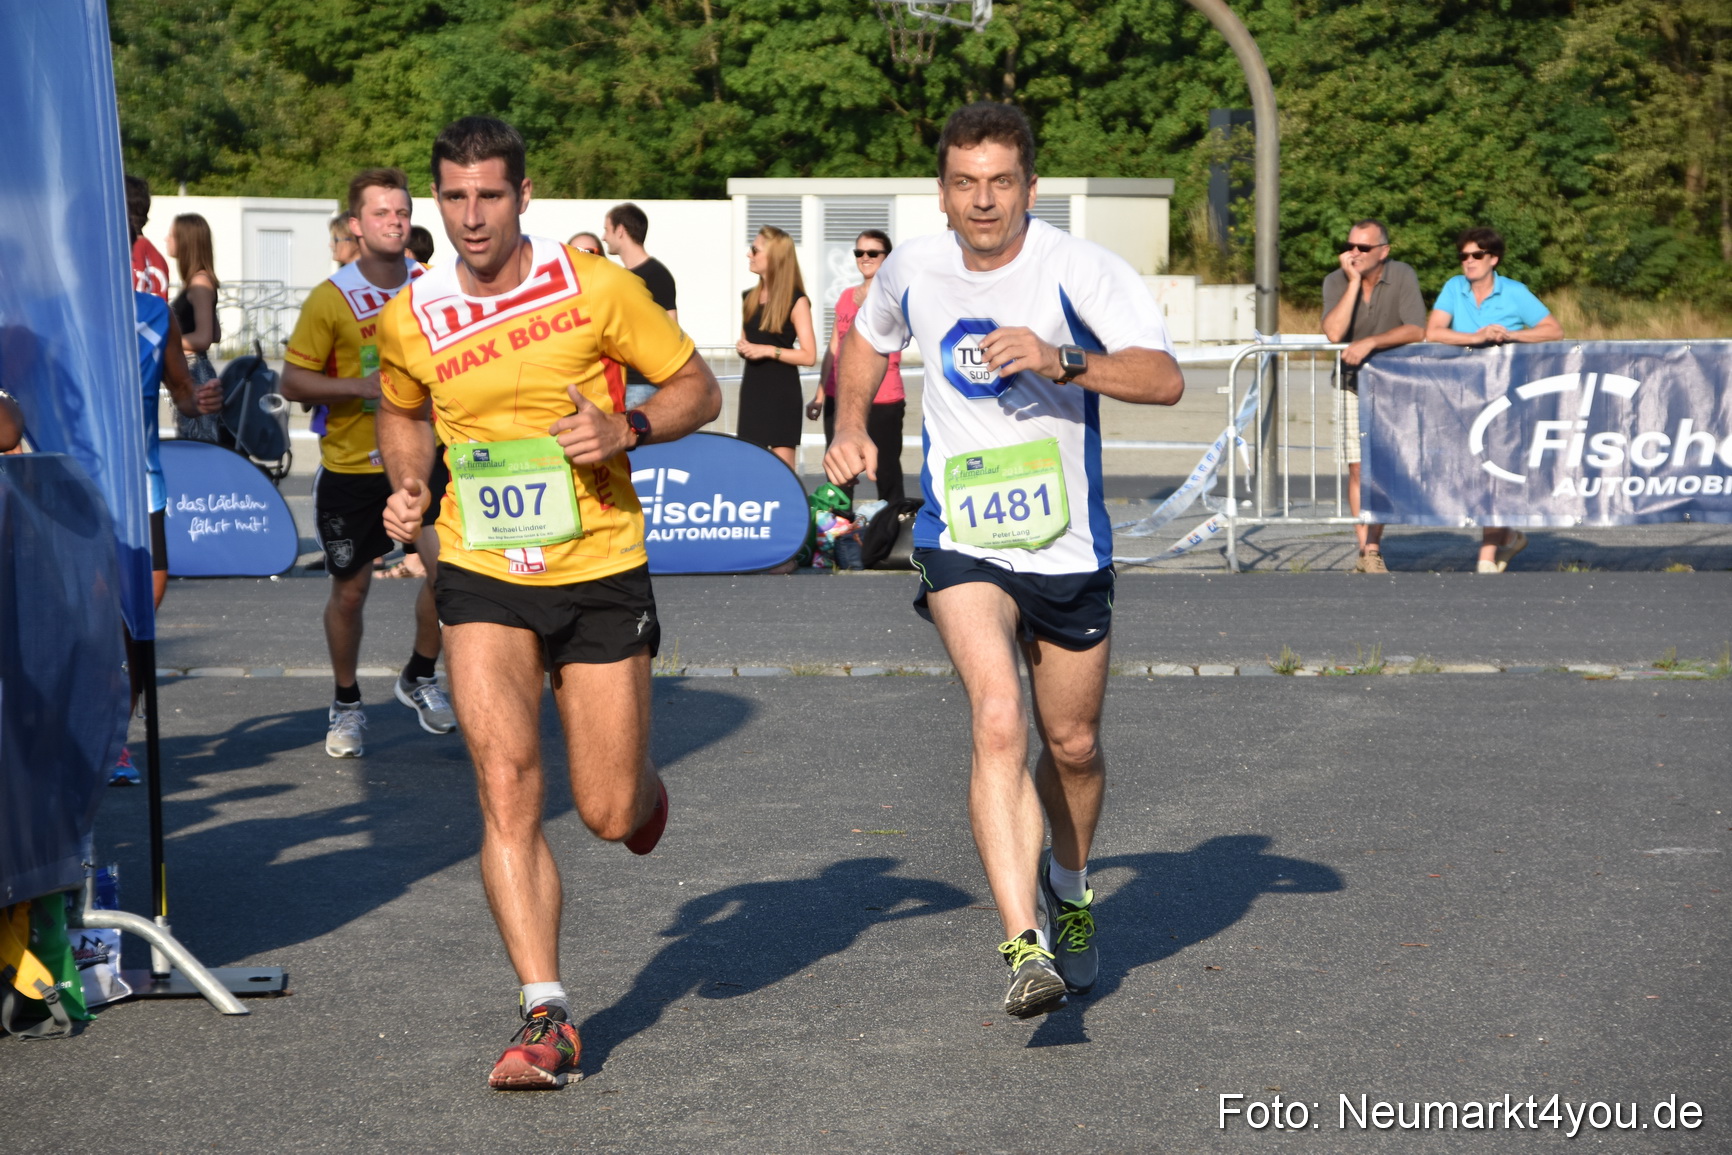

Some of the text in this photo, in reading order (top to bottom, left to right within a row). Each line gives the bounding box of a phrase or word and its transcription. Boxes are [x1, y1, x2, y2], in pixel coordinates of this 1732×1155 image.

[434, 307, 592, 384] MAX BÖGL
[958, 347, 986, 366] TÜ
[467, 459, 506, 469] firmenlauf
[176, 493, 206, 512] das
[208, 492, 267, 512] Lächeln
[478, 482, 547, 519] 907
[638, 493, 780, 525] Fischer
[959, 483, 1051, 528] 1481
[187, 516, 270, 542] fährt mit!
[491, 525, 518, 533] Michael
[646, 526, 771, 541] AUTOMOBILE
[992, 529, 1031, 539] Peter Lang
